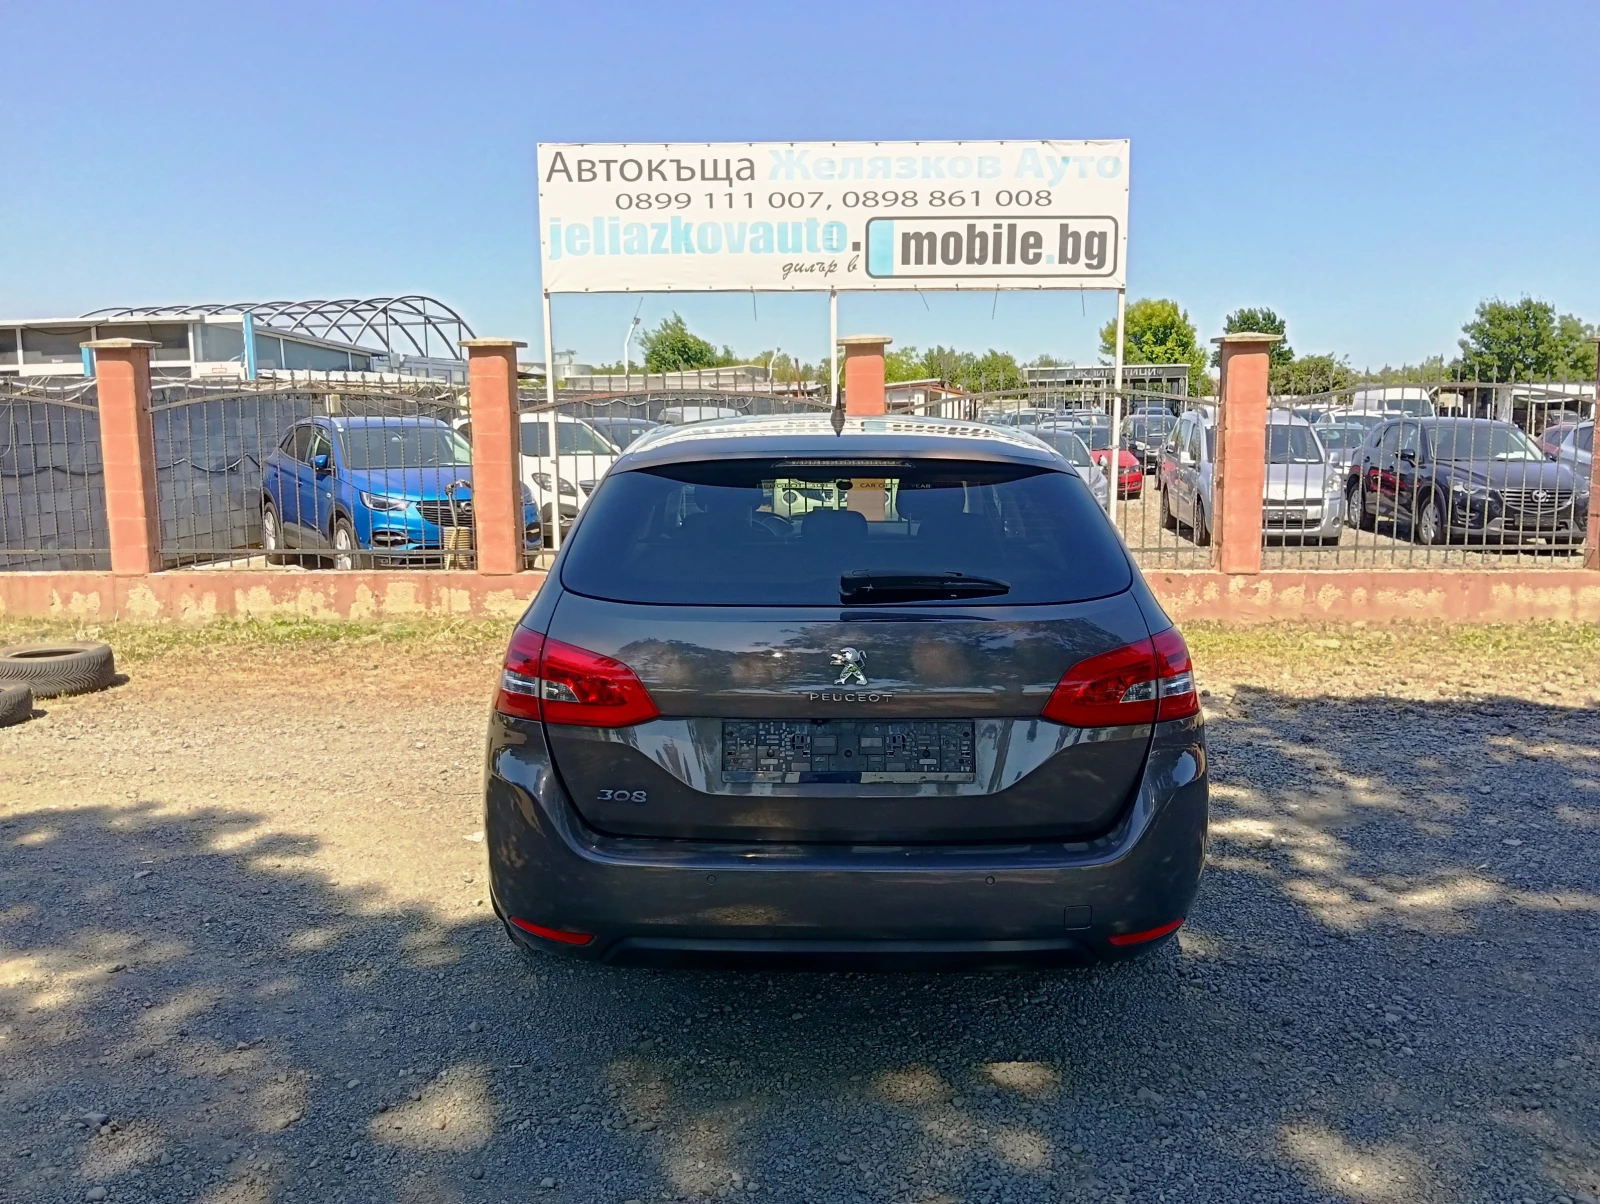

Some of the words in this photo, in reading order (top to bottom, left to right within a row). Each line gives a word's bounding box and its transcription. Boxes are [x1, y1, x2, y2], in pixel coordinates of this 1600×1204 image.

[546, 151, 756, 188] Автокъща
[768, 149, 1002, 181] Желязков
[1014, 147, 1123, 188] Ауто
[615, 193, 692, 210] 0899
[704, 192, 753, 209] 111
[768, 191, 832, 211] 007,
[842, 190, 918, 208] 0898
[928, 190, 981, 207] 861
[995, 189, 1052, 207] 008
[901, 223, 1107, 270] mobile.bg
[782, 260, 838, 280] дилър
[809, 693, 893, 703] PEUGEOT
[597, 789, 647, 803] 308
